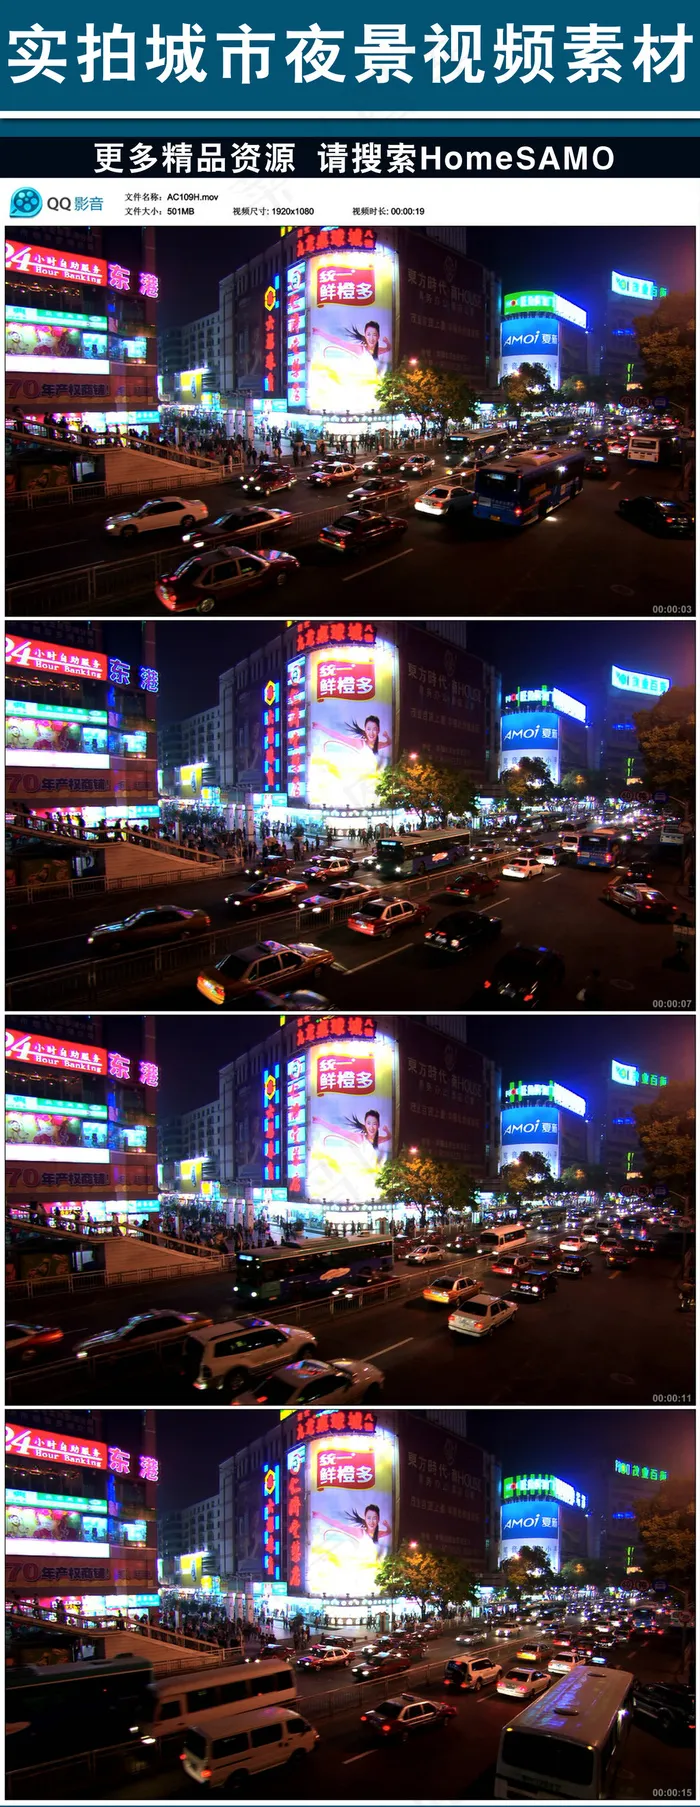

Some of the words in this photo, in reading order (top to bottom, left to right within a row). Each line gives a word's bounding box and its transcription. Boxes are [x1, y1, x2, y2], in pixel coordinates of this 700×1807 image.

[34, 253, 101, 274] 小时自助服务
[35, 265, 60, 277] Hour
[63, 270, 102, 284] Banking
[108, 263, 159, 298] 东港
[319, 269, 356, 283] 统一
[319, 282, 374, 302] 鲜橙多
[34, 647, 101, 668] 小时自助服务
[35, 659, 60, 671] Hour
[63, 664, 102, 678] Banking
[108, 657, 159, 692] 东港
[319, 663, 356, 677] 统一
[319, 676, 374, 696] 鲜橙多
[34, 1042, 101, 1063] 小时自助服务
[35, 1054, 60, 1066] Hour
[63, 1059, 102, 1073] Banking
[108, 1052, 159, 1087] 东港
[319, 1058, 356, 1072] 统一
[319, 1071, 374, 1091] 鲜橙多
[34, 1436, 101, 1457] 小时自助服务
[35, 1448, 60, 1460] Hour
[63, 1453, 102, 1467] Banking
[108, 1446, 159, 1481] 东港
[319, 1452, 356, 1466] 统一
[319, 1465, 374, 1485] 鲜橙多
